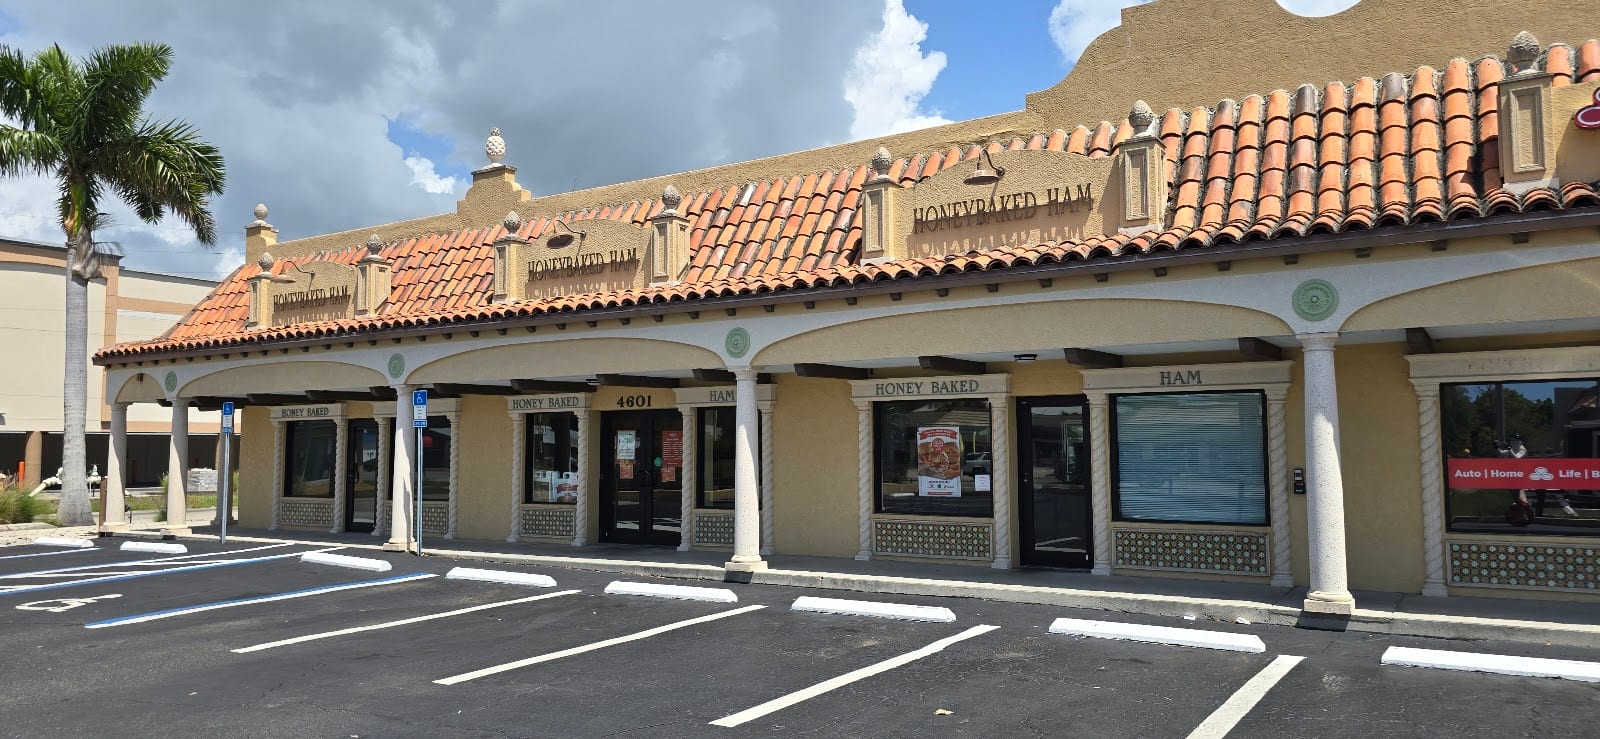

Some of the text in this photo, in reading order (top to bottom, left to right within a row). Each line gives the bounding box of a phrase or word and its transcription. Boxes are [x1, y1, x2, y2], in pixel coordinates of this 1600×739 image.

[913, 182, 1093, 234] HONEYBAKED HAM
[528, 247, 638, 282] HONEYBAKED HAM
[273, 285, 350, 313] HONEYBAKED HAM
[1160, 370, 1202, 385] HAM
[875, 379, 979, 396] HONEY BAKED
[512, 396, 579, 410] HONEY BAKED
[616, 395, 652, 408] 4601
[709, 390, 735, 402] HAM
[281, 407, 330, 418] HONEY BAKED
[1454, 469, 1482, 478] Auto
[1490, 469, 1524, 478] Home
[1558, 469, 1582, 478] Life
